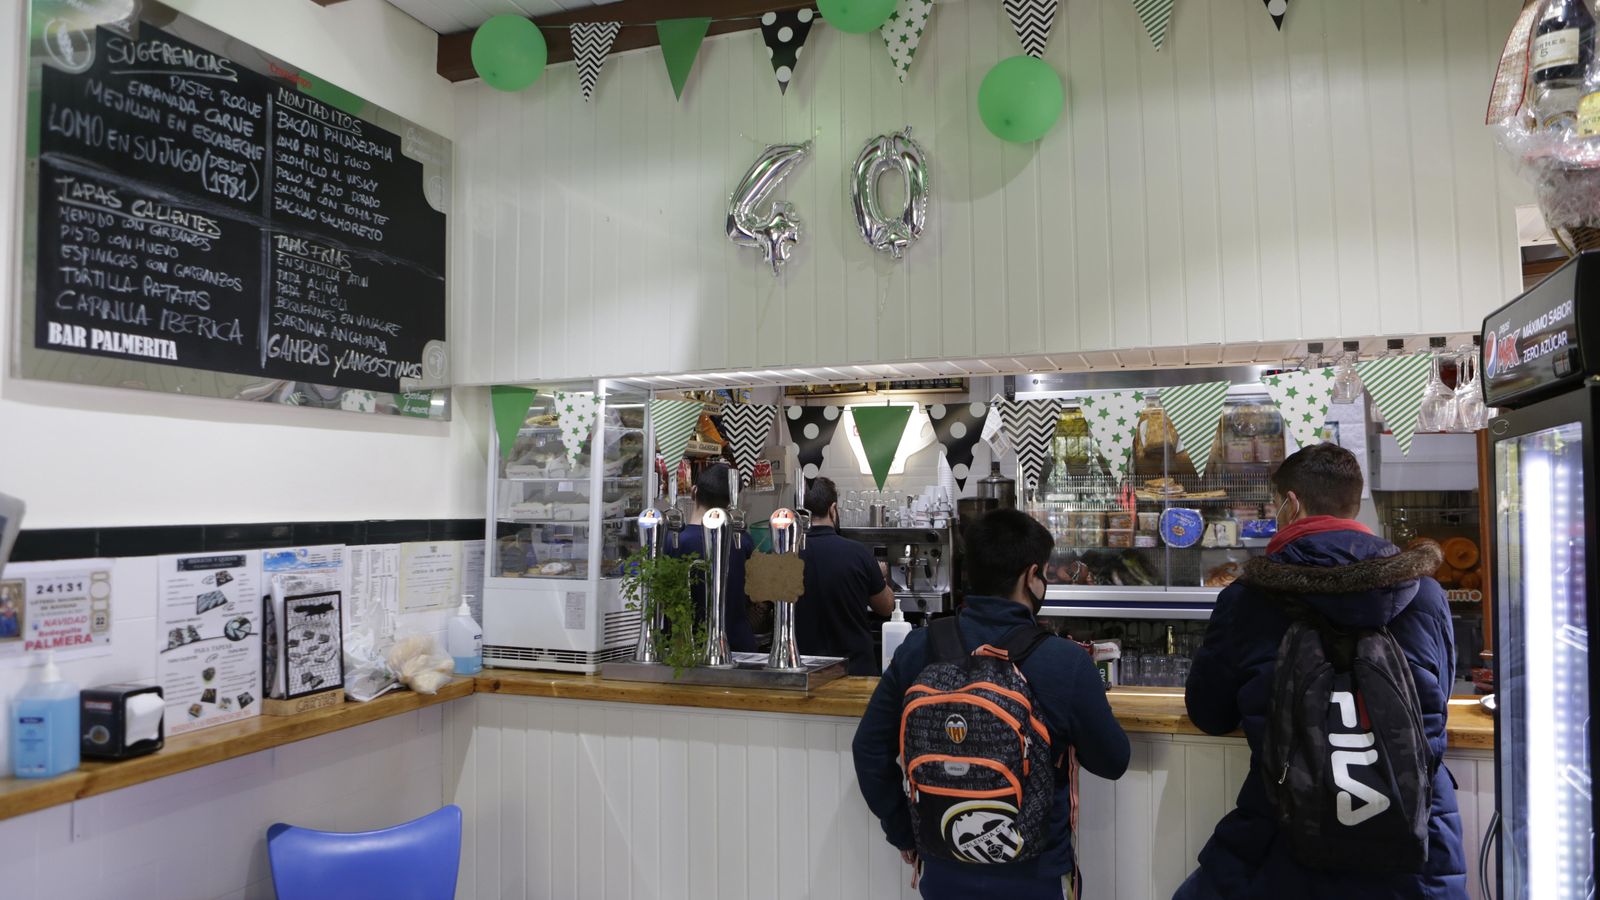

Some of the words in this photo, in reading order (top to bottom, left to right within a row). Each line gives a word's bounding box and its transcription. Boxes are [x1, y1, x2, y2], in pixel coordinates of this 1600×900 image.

[106, 38, 237, 76] SUGERENCIAS
[128, 80, 199, 115] EMPANADA
[204, 109, 254, 136] CARNE
[170, 75, 215, 101] PASTEL
[222, 90, 263, 119] ROQUE
[278, 87, 363, 135] MONTADITOS
[85, 78, 160, 124] MEJILLON
[167, 114, 187, 132] EN
[192, 124, 265, 160] ESCABECHE
[276, 110, 319, 139] BACON
[48, 103, 104, 146] LOMO
[107, 129, 130, 150] EN
[134, 136, 155, 163] SU
[159, 137, 202, 173] JUGO
[304, 143, 319, 158] EN
[323, 147, 339, 165] SU
[276, 165, 303, 184] POLLO
[305, 176, 317, 189] AL
[321, 182, 344, 197] AJO
[331, 169, 343, 182] AL
[55, 177, 122, 208] TAPAS
[132, 200, 221, 236] CALIENTES
[274, 182, 311, 202] SALMON
[316, 195, 338, 210] CON
[59, 206, 114, 228] MENUDO
[122, 218, 145, 231] CON
[319, 211, 383, 242] SALMOREJO
[61, 225, 100, 243] PISTO
[108, 235, 132, 249] CON
[135, 239, 179, 258] HUEVO
[273, 235, 309, 256] TAPAS
[59, 267, 139, 293] TORTILLA
[143, 275, 210, 311] PATATAS
[146, 259, 168, 274] CON
[174, 264, 243, 292] GARBANZOS
[160, 308, 244, 345] IBERICA
[273, 312, 327, 338] SARDINA
[340, 313, 354, 325] EN
[356, 314, 402, 337] VINAGRE
[1523, 314, 1547, 339] MÁXIMO
[1548, 300, 1572, 325] SABOR
[48, 321, 87, 349] BAR
[91, 328, 178, 361] PALMERITA
[267, 333, 330, 366] GAMBAS
[1523, 344, 1539, 363] ZERO
[1540, 330, 1568, 356] AZÚCAR
[43, 615, 87, 627] NAVIDAD
[24, 633, 93, 651] PALMERA
[1328, 689, 1390, 826] FILA
[961, 832, 996, 850] VALENCIA
